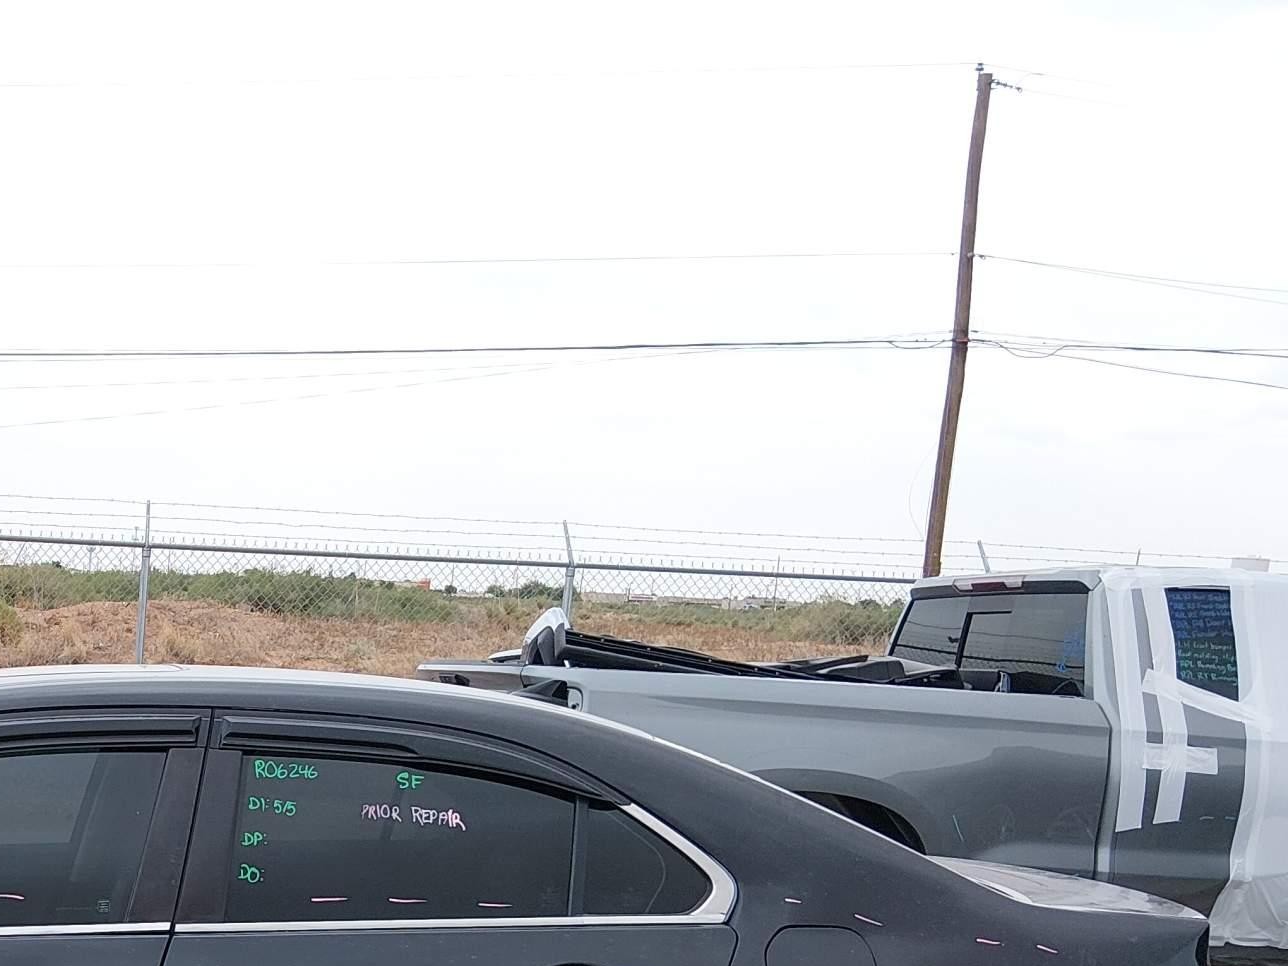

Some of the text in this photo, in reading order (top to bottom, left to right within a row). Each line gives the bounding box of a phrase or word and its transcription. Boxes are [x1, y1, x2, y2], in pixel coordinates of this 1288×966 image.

[396, 772, 425, 789] SF
[273, 800, 297, 816] 5/5
[361, 805, 466, 831] PRIOR REPAIR
[241, 832, 268, 846] DP:
[238, 864, 265, 883] DO:
